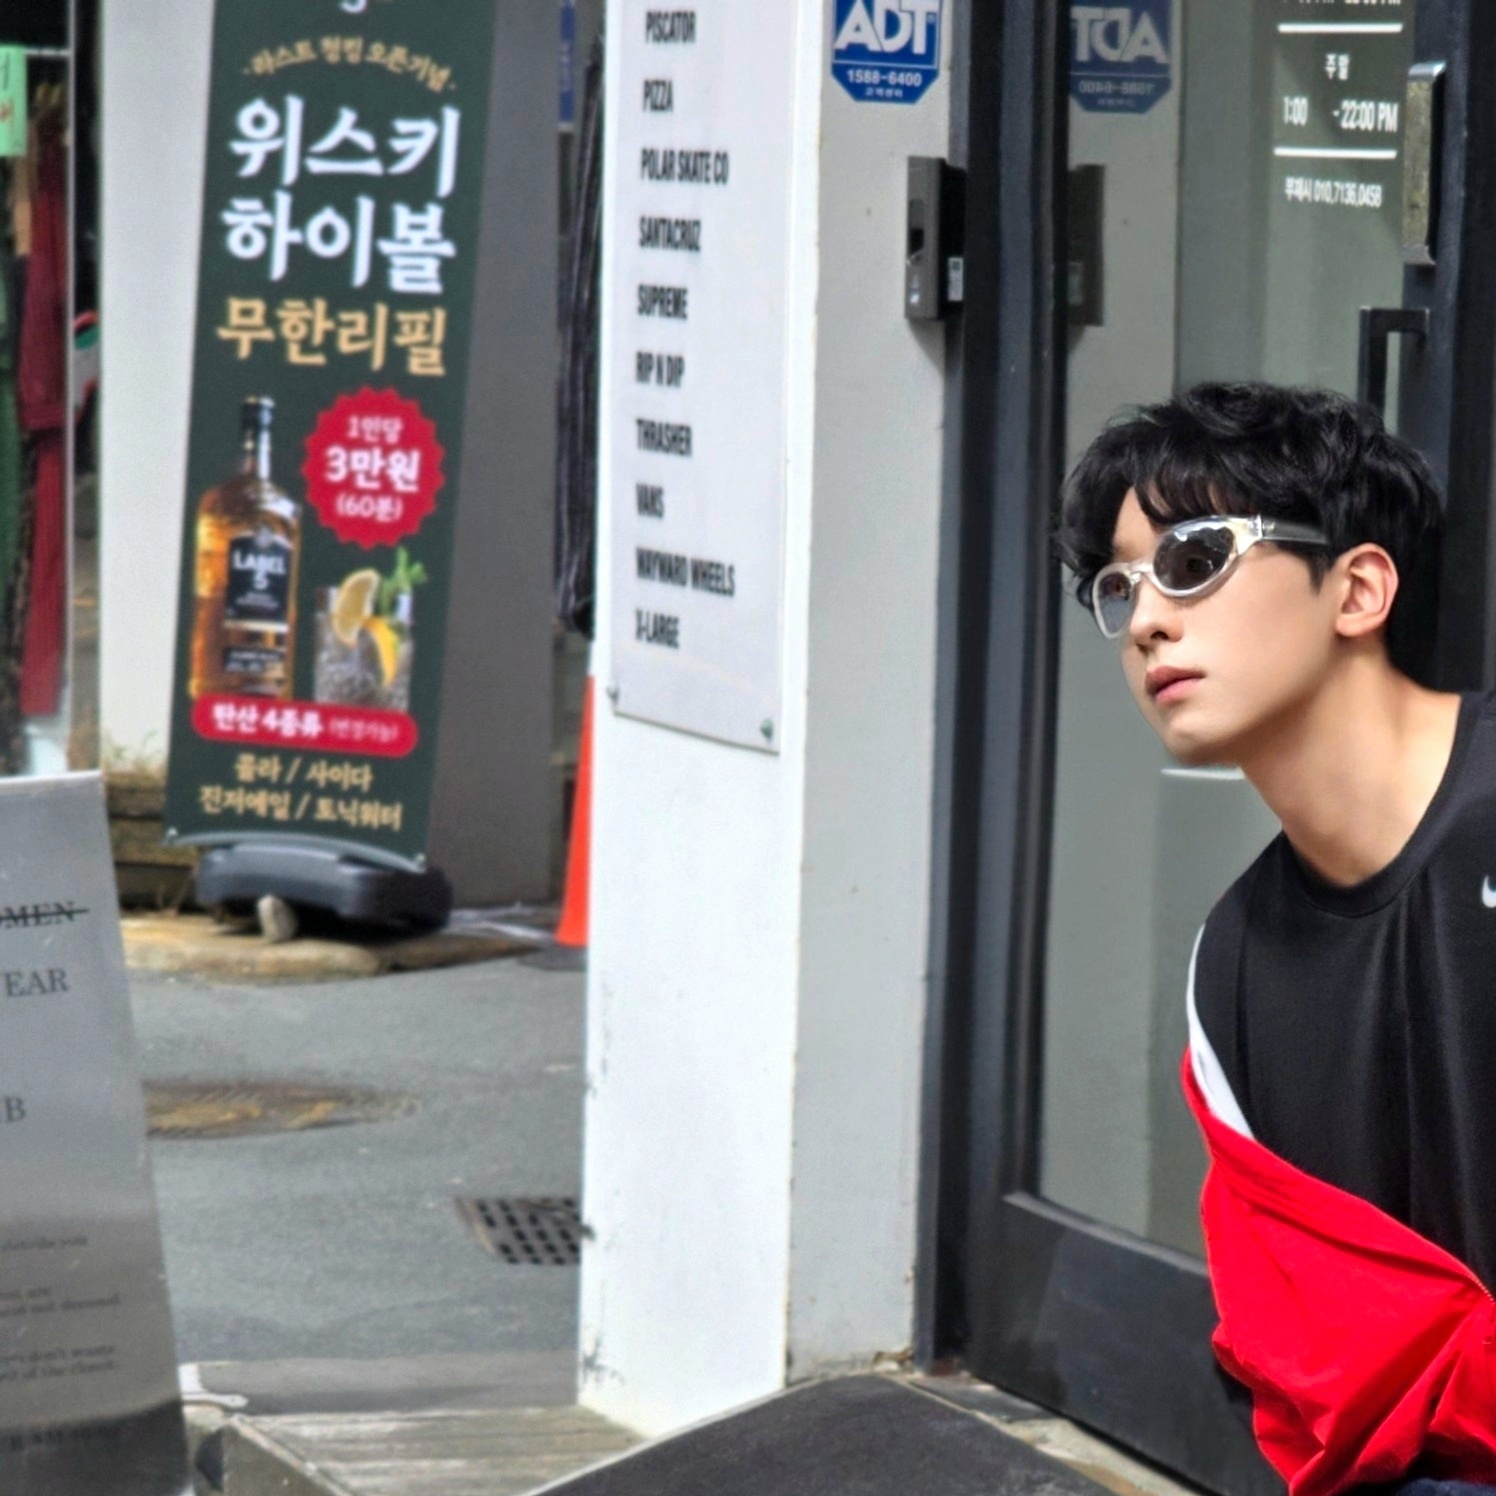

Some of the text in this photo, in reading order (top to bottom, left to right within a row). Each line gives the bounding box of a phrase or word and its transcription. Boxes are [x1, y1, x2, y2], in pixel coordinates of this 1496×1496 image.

[646, 11, 696, 44] PISCATOR
[835, 0, 938, 55] ADT
[847, 69, 922, 88] 1588-6400
[1325, 54, 1349, 80] 주말
[643, 79, 673, 112] PIZZA
[1378, 102, 1398, 133] PM
[230, 93, 461, 198] 위스키
[641, 148, 729, 186] POLAR SKATE CO
[220, 188, 458, 294] 하이볼
[639, 216, 701, 252] SANTACRUZ
[638, 284, 688, 320] SUPREME
[216, 296, 448, 377] 무한리필
[636, 352, 685, 388] RIP N DIP
[348, 414, 403, 443] 1인당
[636, 418, 692, 457] THRASHER
[325, 444, 421, 493] 3만원
[335, 494, 403, 523] (60분)
[636, 483, 664, 519] VANS
[233, 552, 286, 575] LABEL
[636, 547, 735, 597] WAYWARD WHEELS
[635, 608, 679, 650] X-LARGE
[306, 758, 373, 792] 사이다
[0, 902, 77, 930] MEN
[2, 967, 70, 998] EAR
